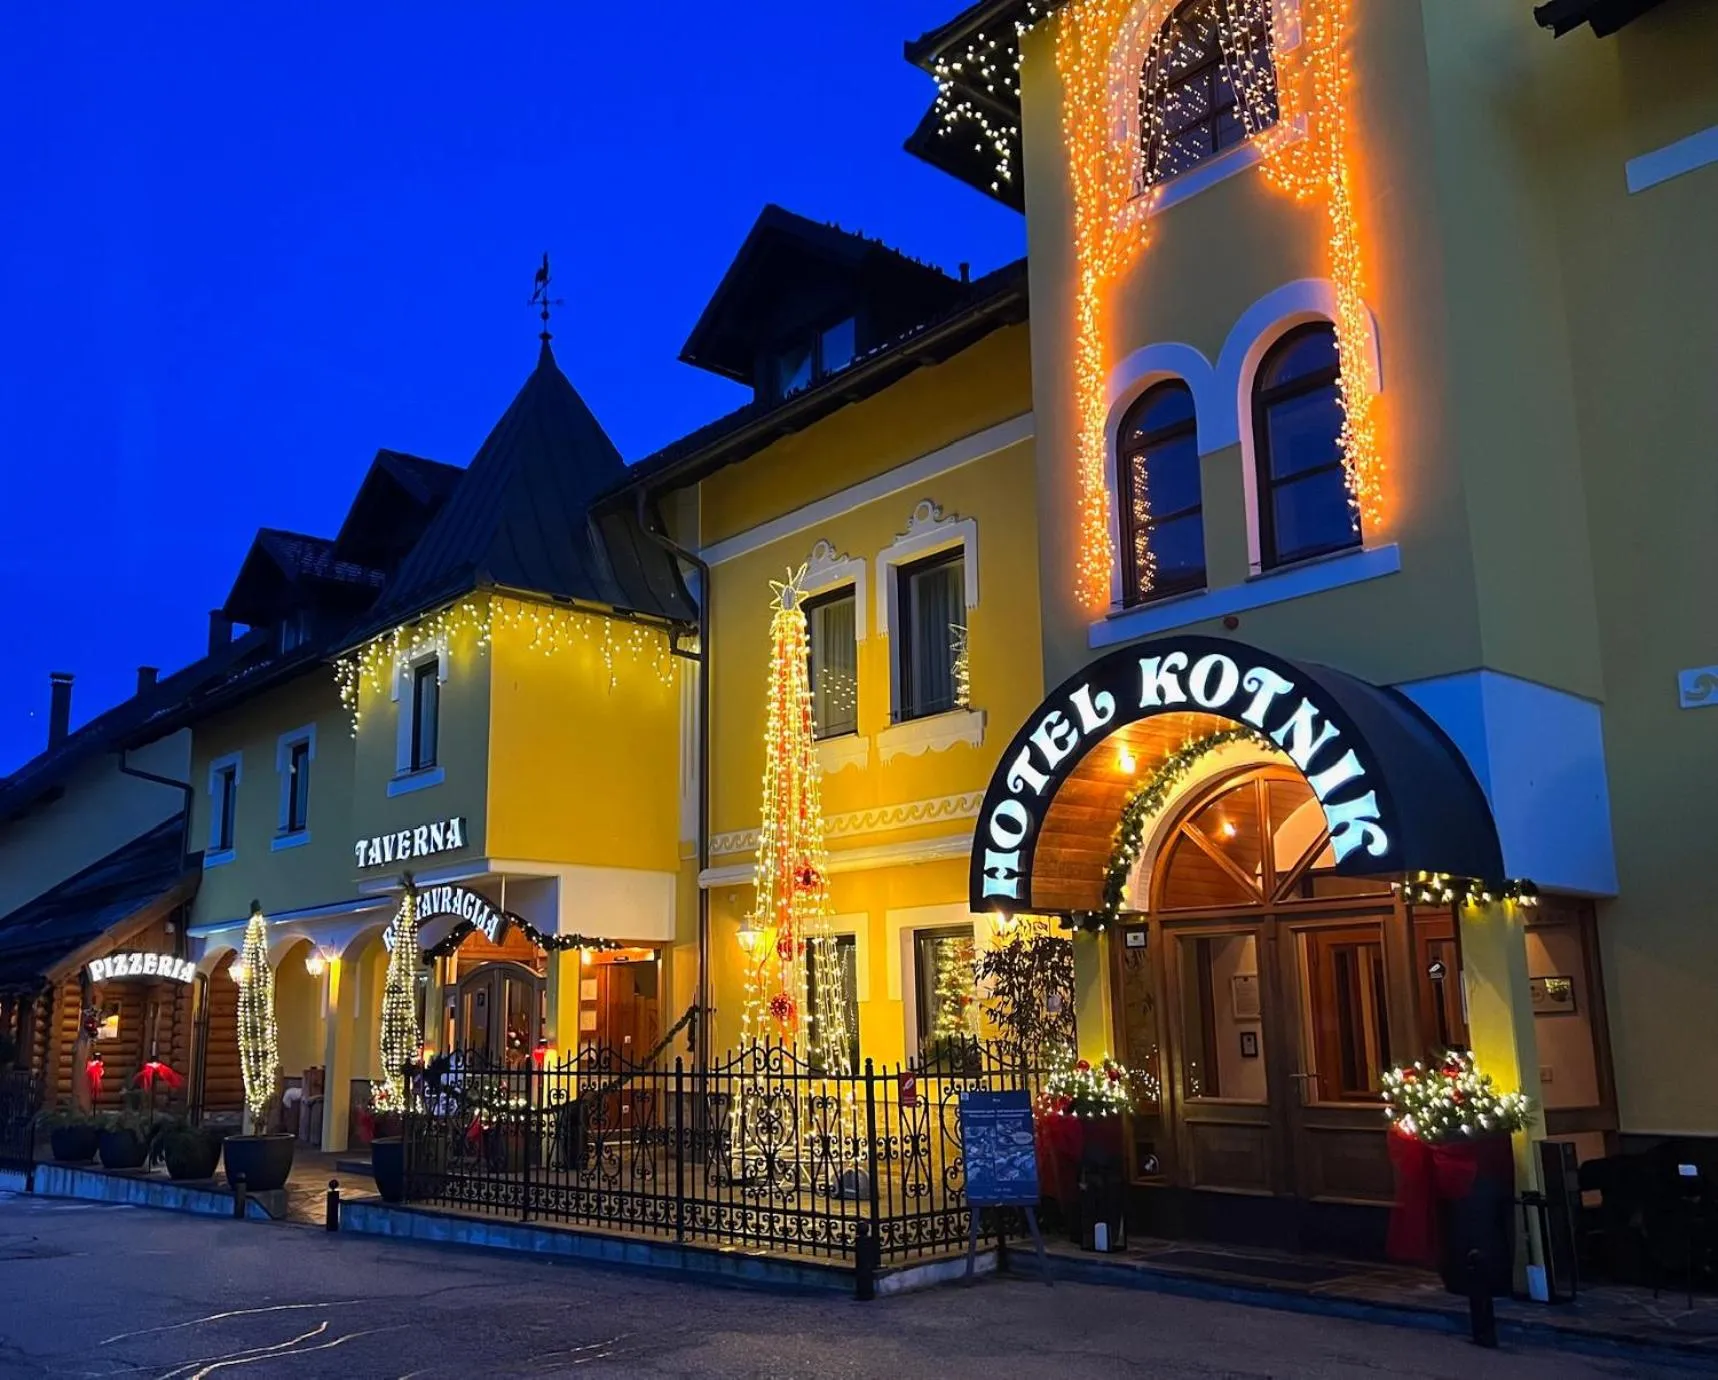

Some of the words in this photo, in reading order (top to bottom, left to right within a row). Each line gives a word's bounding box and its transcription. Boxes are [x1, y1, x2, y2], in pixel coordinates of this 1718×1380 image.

[982, 683, 1116, 899] HOTEL
[1138, 651, 1388, 865] KOTNIK
[354, 817, 463, 868] TAVERNA
[88, 953, 197, 983] PIZZERIA
